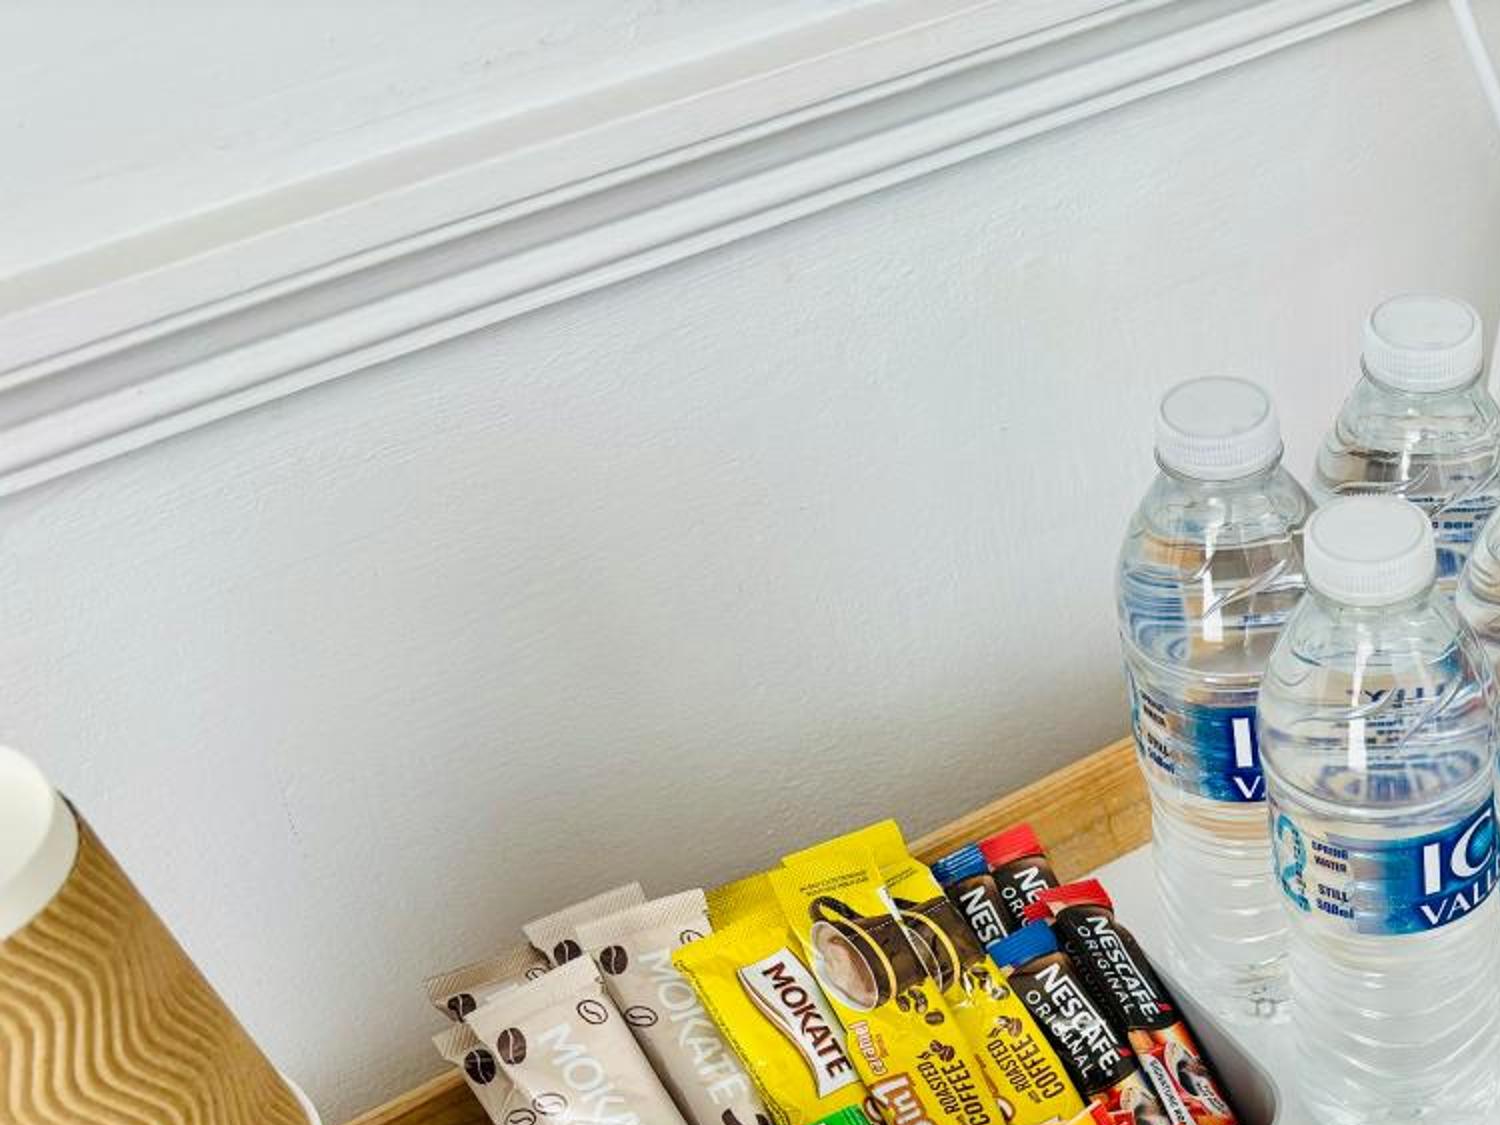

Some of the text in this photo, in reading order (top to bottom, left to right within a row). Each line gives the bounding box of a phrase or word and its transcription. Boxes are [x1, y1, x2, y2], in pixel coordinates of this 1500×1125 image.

[1422, 807, 1494, 896] IC
[1077, 926, 1136, 1014] ORIGINAL
[761, 961, 853, 1079] MOKATE
[917, 1061, 961, 1115] ROASTED
[987, 1039, 1031, 1093] ROASTED
[1010, 1034, 1065, 1099] COFFEE
